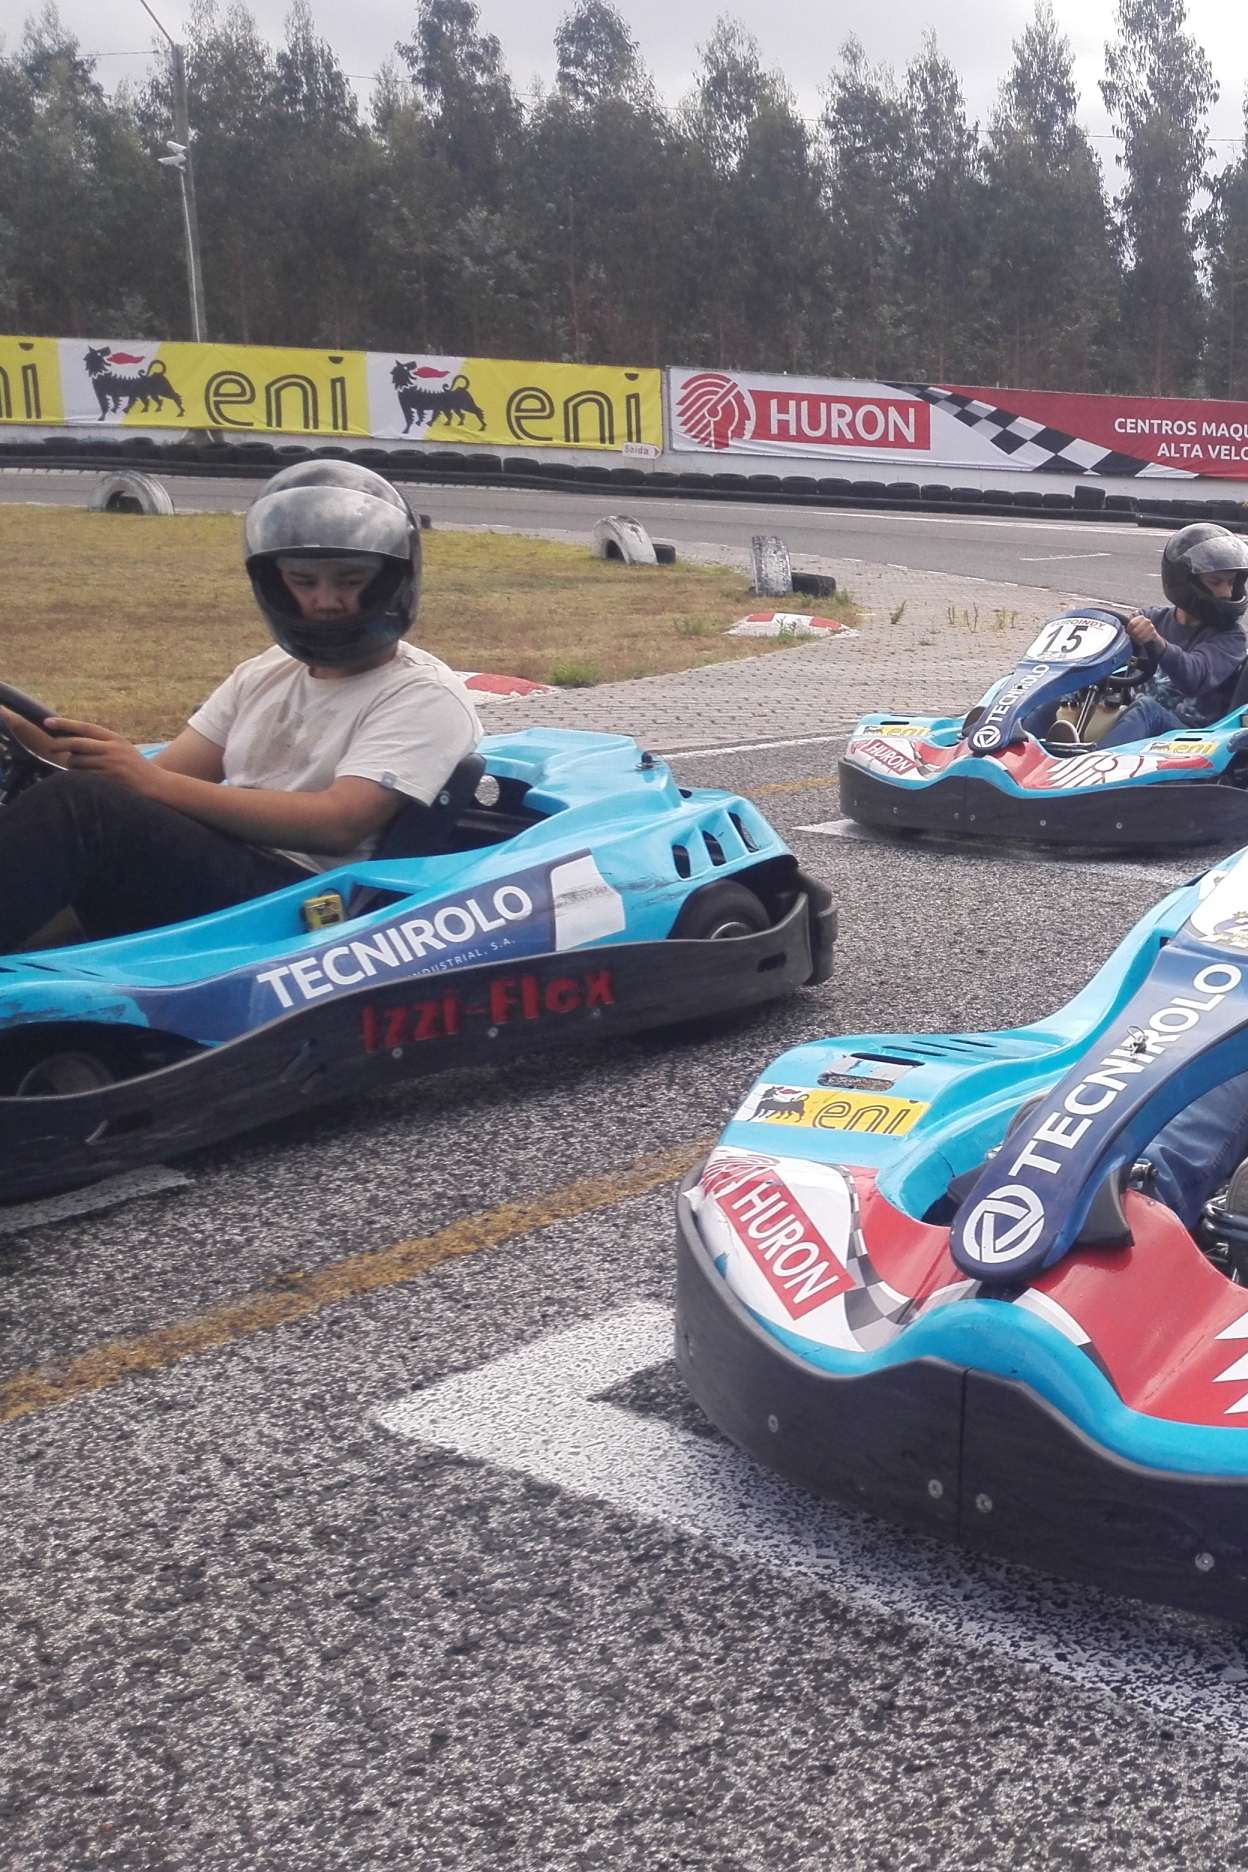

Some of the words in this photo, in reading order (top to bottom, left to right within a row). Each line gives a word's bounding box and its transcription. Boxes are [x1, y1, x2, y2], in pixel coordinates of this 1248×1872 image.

[204, 355, 348, 431] eni
[506, 372, 642, 445] eni
[770, 398, 916, 443] HURON
[1114, 417, 1197, 436] CENTROS
[1156, 442, 1204, 459] ALTA
[1041, 625, 1089, 655] 15
[866, 742, 913, 771] HURON
[256, 885, 533, 1009] TECNIROLO
[1008, 963, 1243, 1178] TECNIROLO
[812, 1099, 919, 1135] eni
[731, 1181, 839, 1305] HURON
